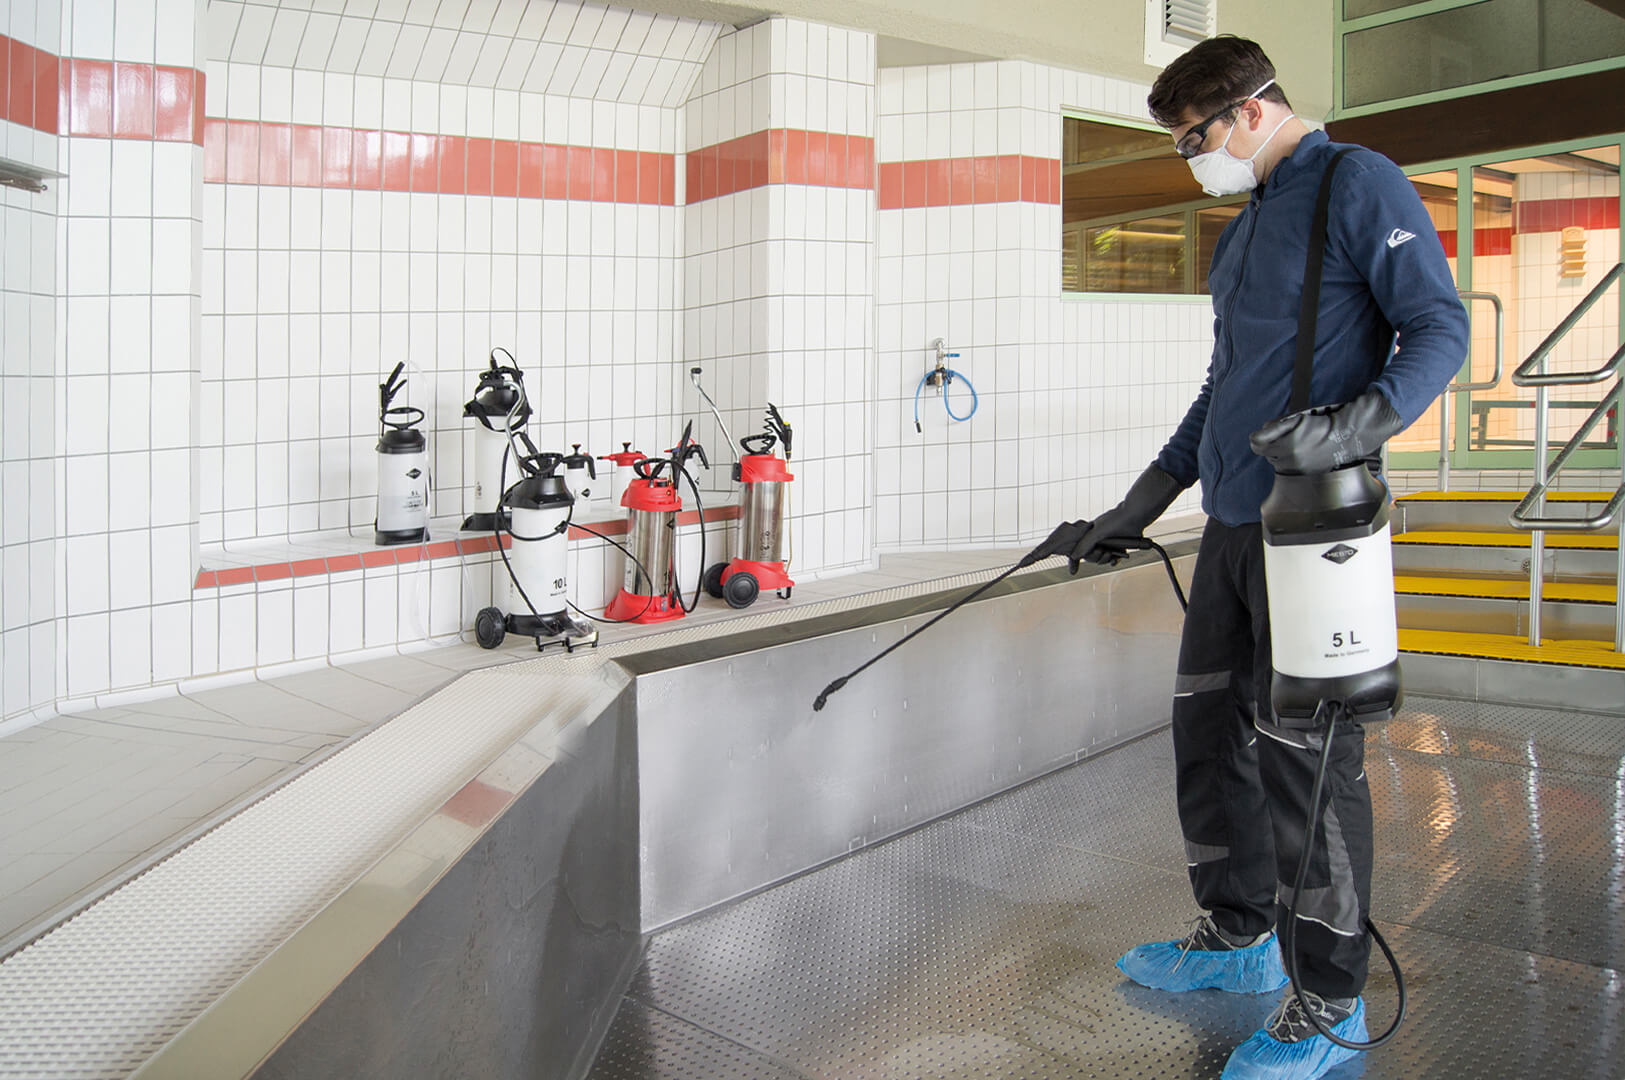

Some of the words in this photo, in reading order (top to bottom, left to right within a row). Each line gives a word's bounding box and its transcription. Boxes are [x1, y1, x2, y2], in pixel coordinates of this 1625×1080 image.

[552, 577, 563, 589] 10
[1332, 632, 1343, 648] 5
[1350, 630, 1361, 645] L
